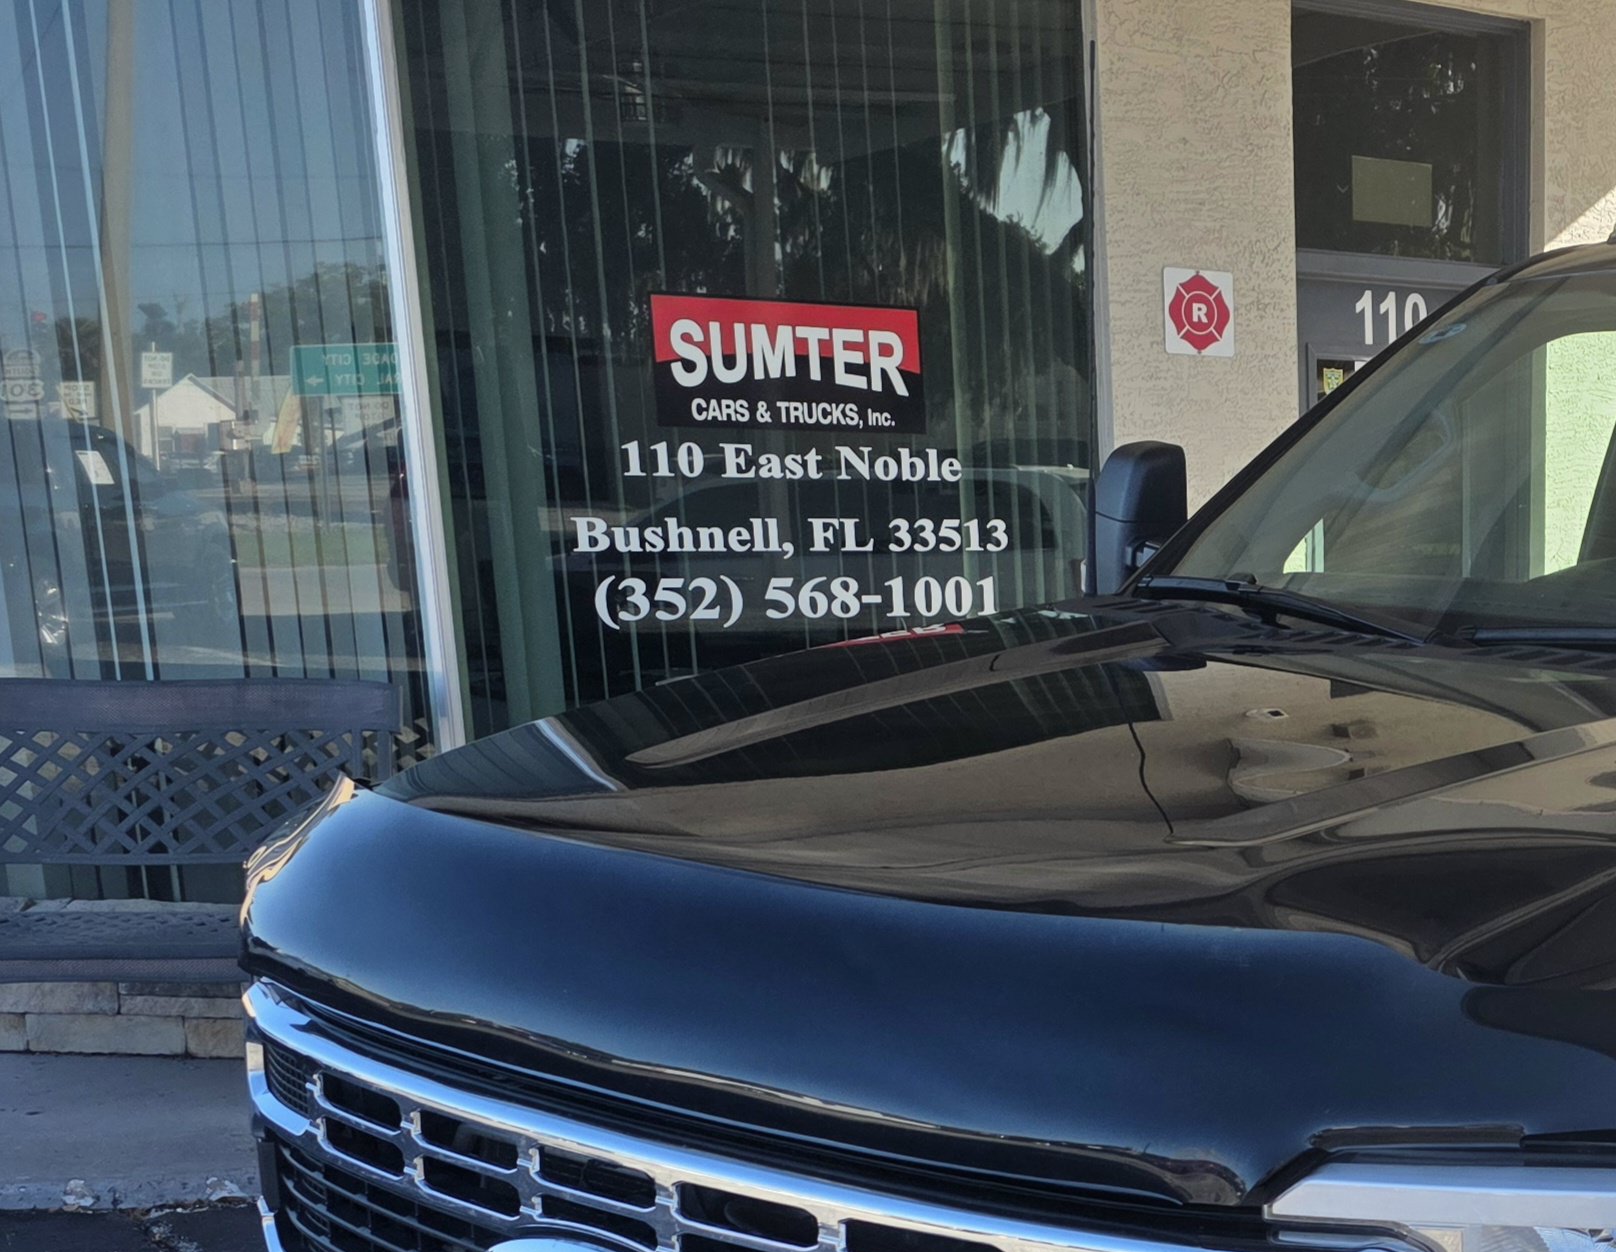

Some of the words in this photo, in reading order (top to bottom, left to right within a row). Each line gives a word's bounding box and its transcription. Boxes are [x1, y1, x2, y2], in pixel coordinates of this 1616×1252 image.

[1192, 303, 1208, 323] R
[1355, 290, 1428, 345] 110
[669, 319, 909, 397] SUMTER
[691, 398, 750, 422] CARS
[756, 402, 772, 423] &
[776, 402, 864, 428] TRUCKS,
[867, 408, 896, 427] Inc.
[621, 441, 704, 477] 110
[719, 443, 823, 480] East
[835, 446, 962, 482] Noble
[570, 517, 794, 559] Bushnell,
[808, 518, 874, 552] FL
[888, 518, 1008, 552] 33513
[594, 575, 742, 629] (352)
[765, 576, 1000, 620] 568-1001
